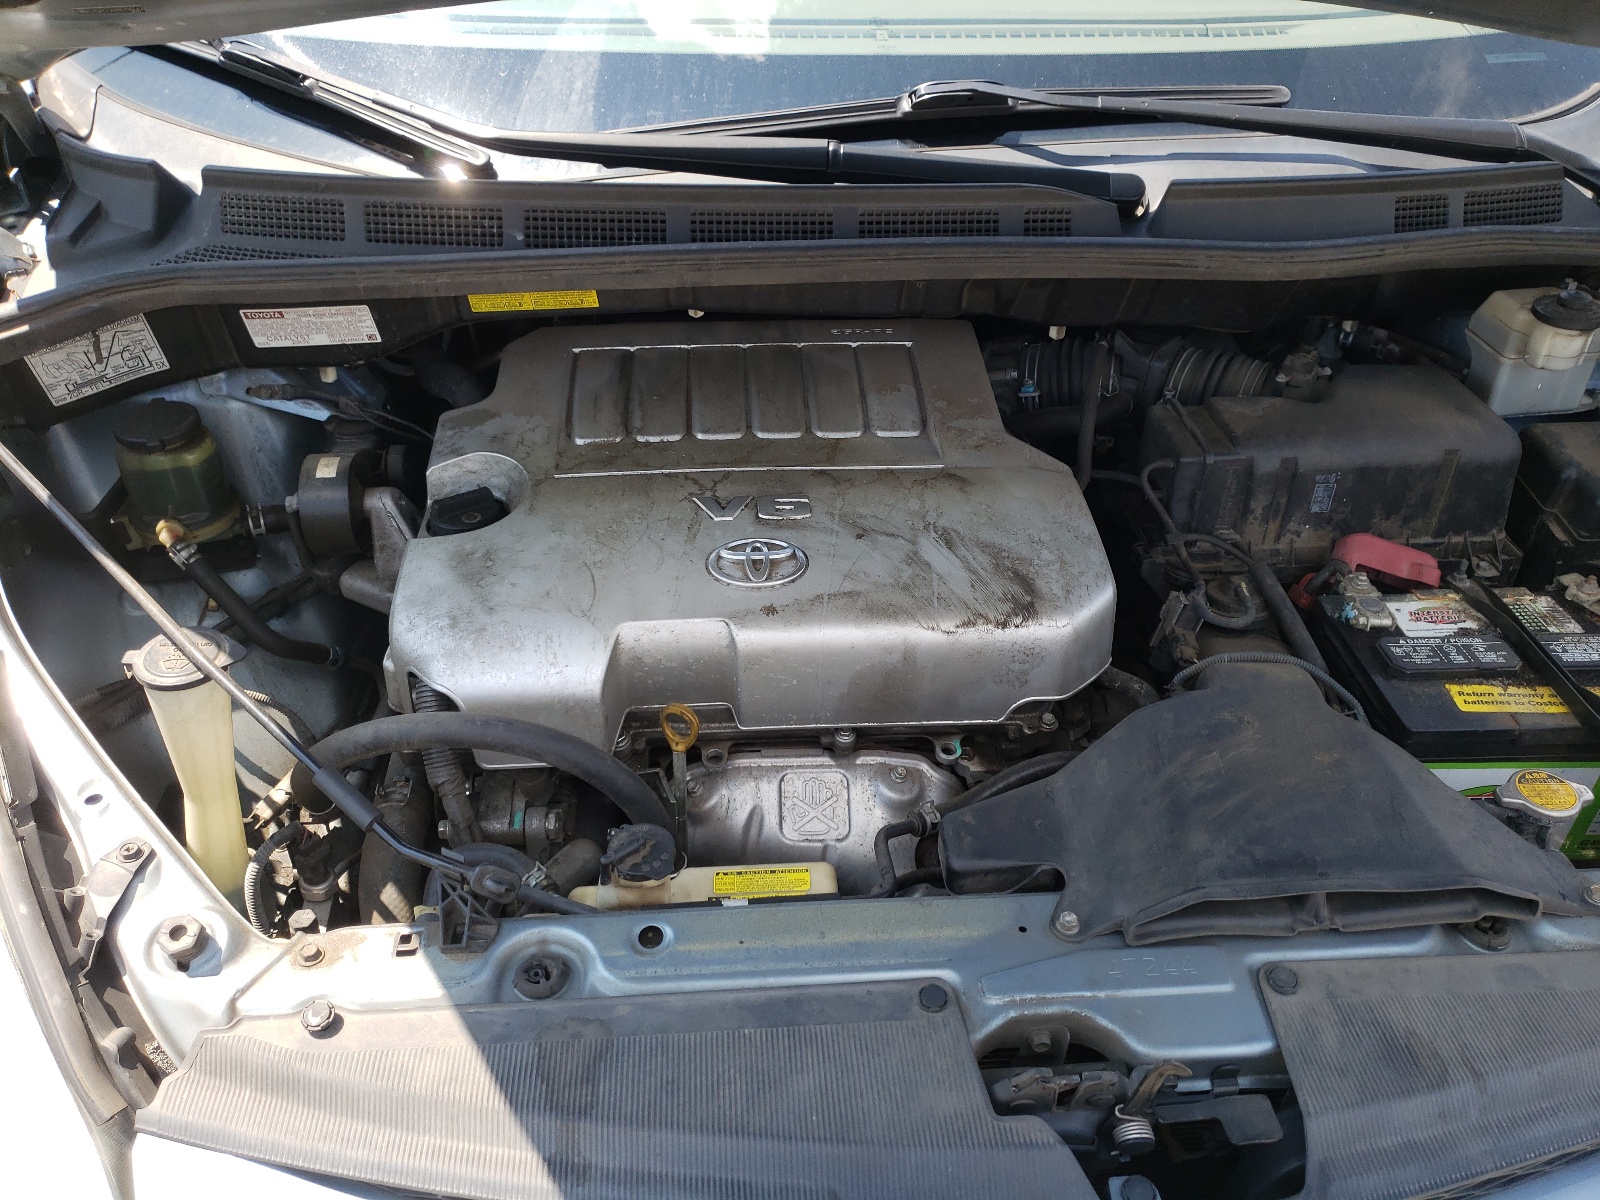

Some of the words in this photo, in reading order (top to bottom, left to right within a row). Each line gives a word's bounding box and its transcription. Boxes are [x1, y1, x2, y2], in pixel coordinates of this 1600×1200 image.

[266, 333, 311, 342] CATALYST
[155, 360, 166, 370] 5X
[691, 494, 812, 522] V6
